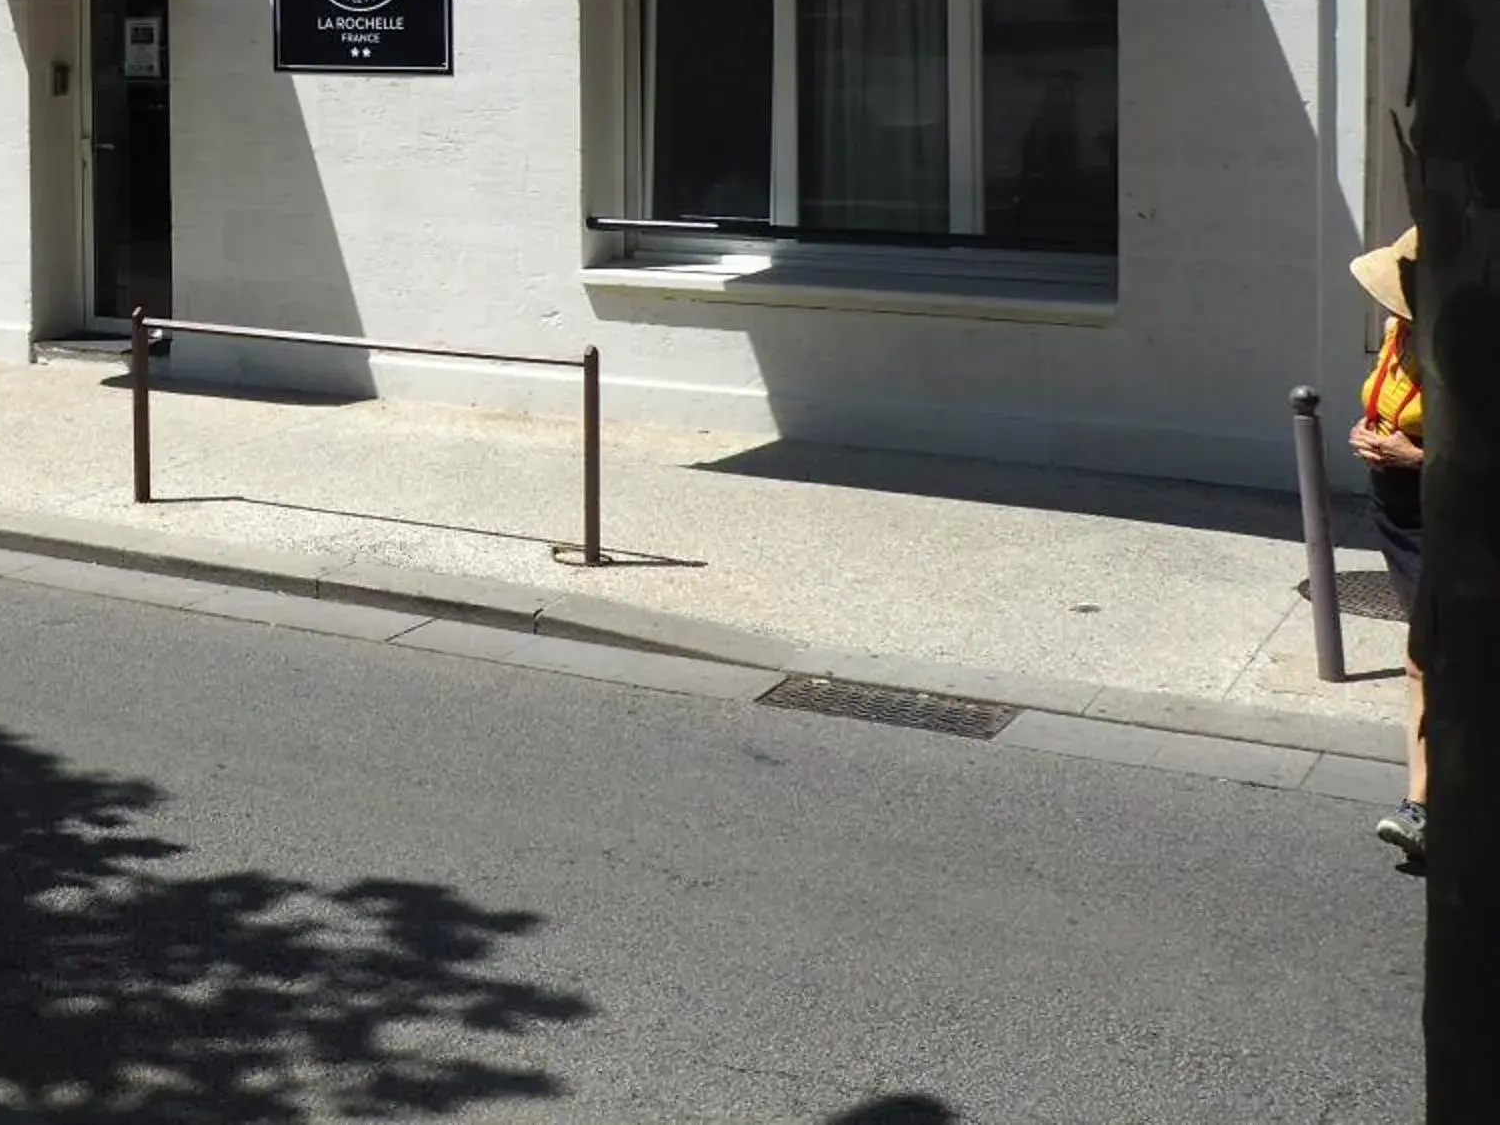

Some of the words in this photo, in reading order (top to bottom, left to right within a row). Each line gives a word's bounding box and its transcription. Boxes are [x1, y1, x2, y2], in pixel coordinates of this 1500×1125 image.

[317, 16, 335, 30] LA
[336, 16, 405, 31] ROCHELLE
[341, 32, 381, 44] FRANCE
